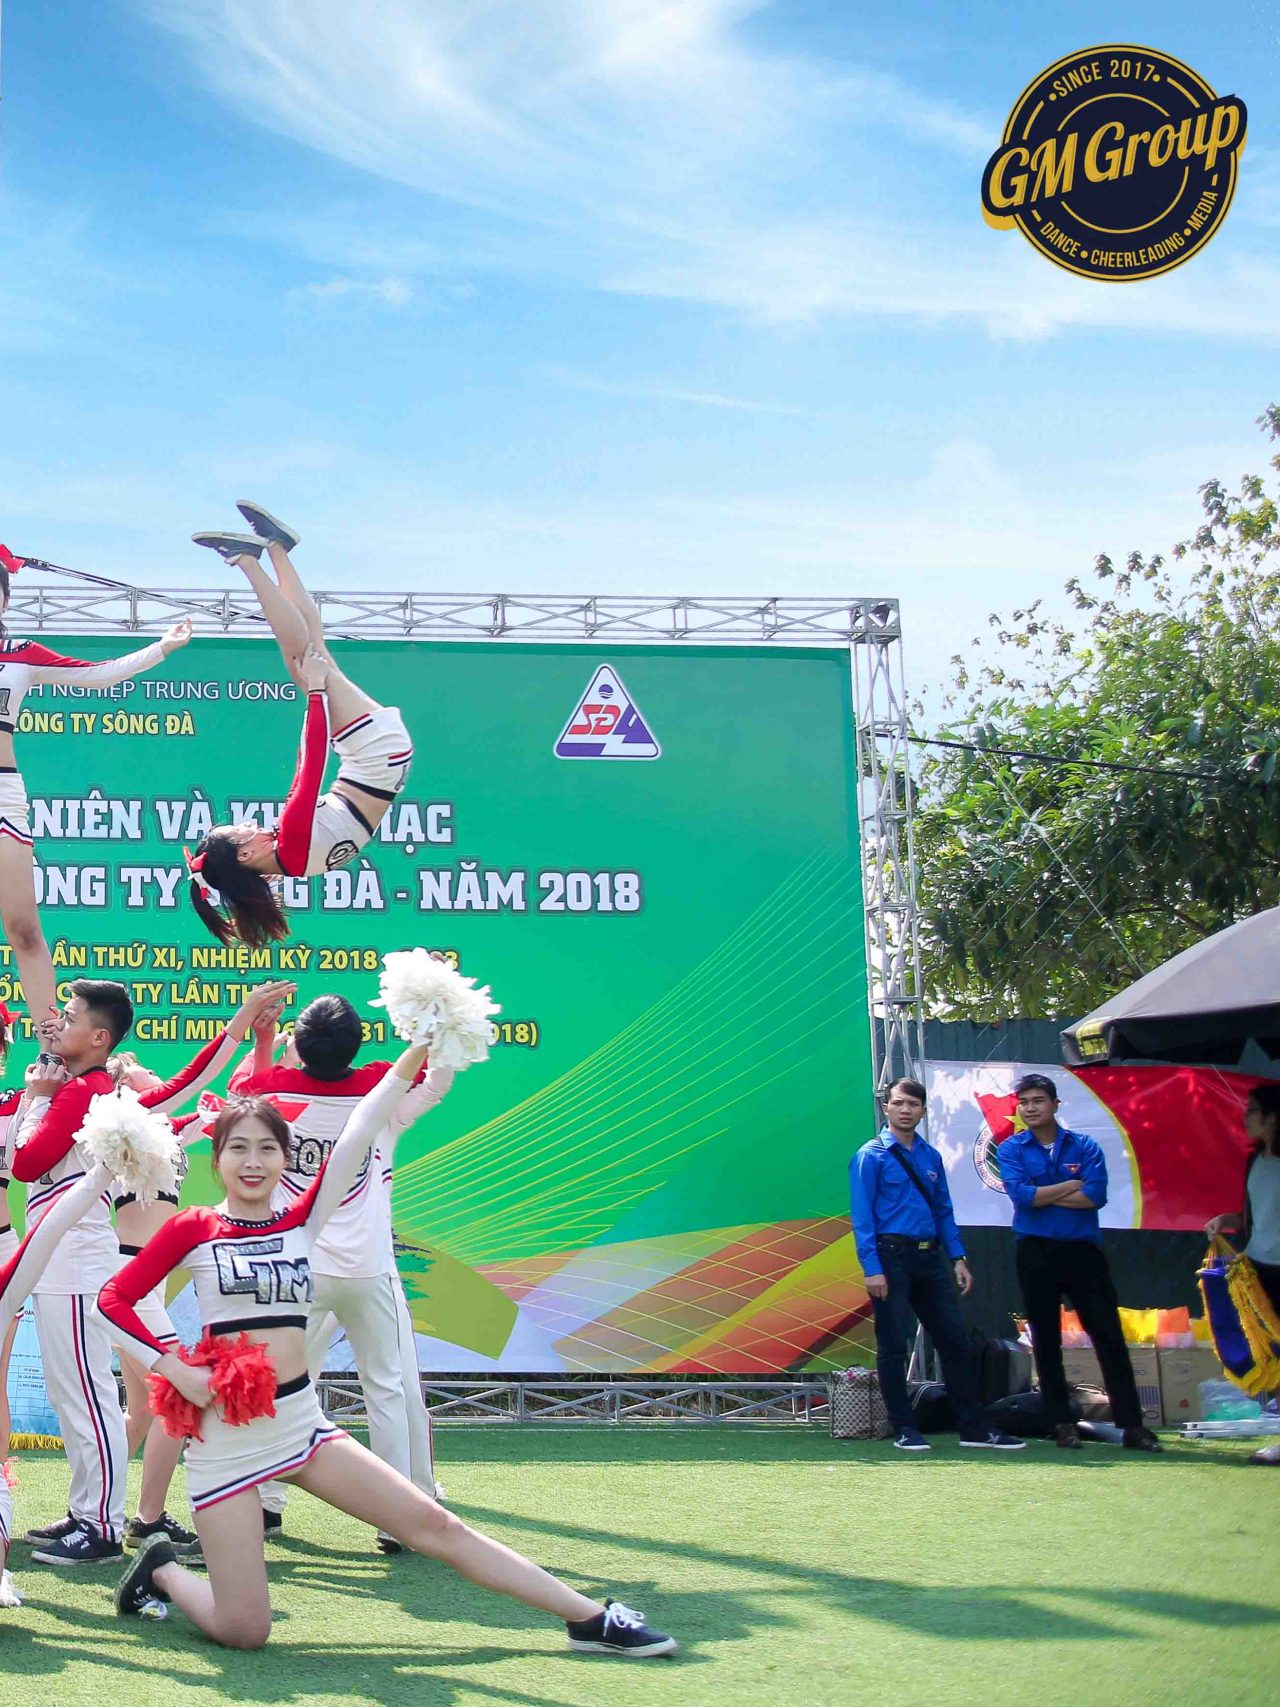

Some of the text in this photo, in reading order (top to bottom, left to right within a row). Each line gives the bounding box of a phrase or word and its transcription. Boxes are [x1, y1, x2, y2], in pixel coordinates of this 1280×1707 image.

[141, 681, 220, 701] TRUNG
[227, 680, 297, 701] ƯƠNG
[70, 712, 97, 734] TY
[102, 709, 160, 736] SÔNG
[165, 710, 196, 736] ĐÀ
[32, 788, 143, 841] NIÊN
[154, 791, 215, 841] VÀ
[121, 866, 187, 907] TY
[323, 859, 385, 910] ĐÀ
[419, 861, 526, 911] NĂM
[538, 872, 641, 912] 2018
[52, 940, 87, 967] ẦN
[92, 942, 146, 968] THỨ
[152, 947, 185, 971] XI,
[191, 945, 272, 975] NHIỆM
[279, 943, 312, 970] KỲ
[319, 949, 379, 971] 2018
[132, 983, 165, 1004] TY
[170, 977, 220, 1004] LẦN
[135, 1015, 177, 1040] CHÍ
